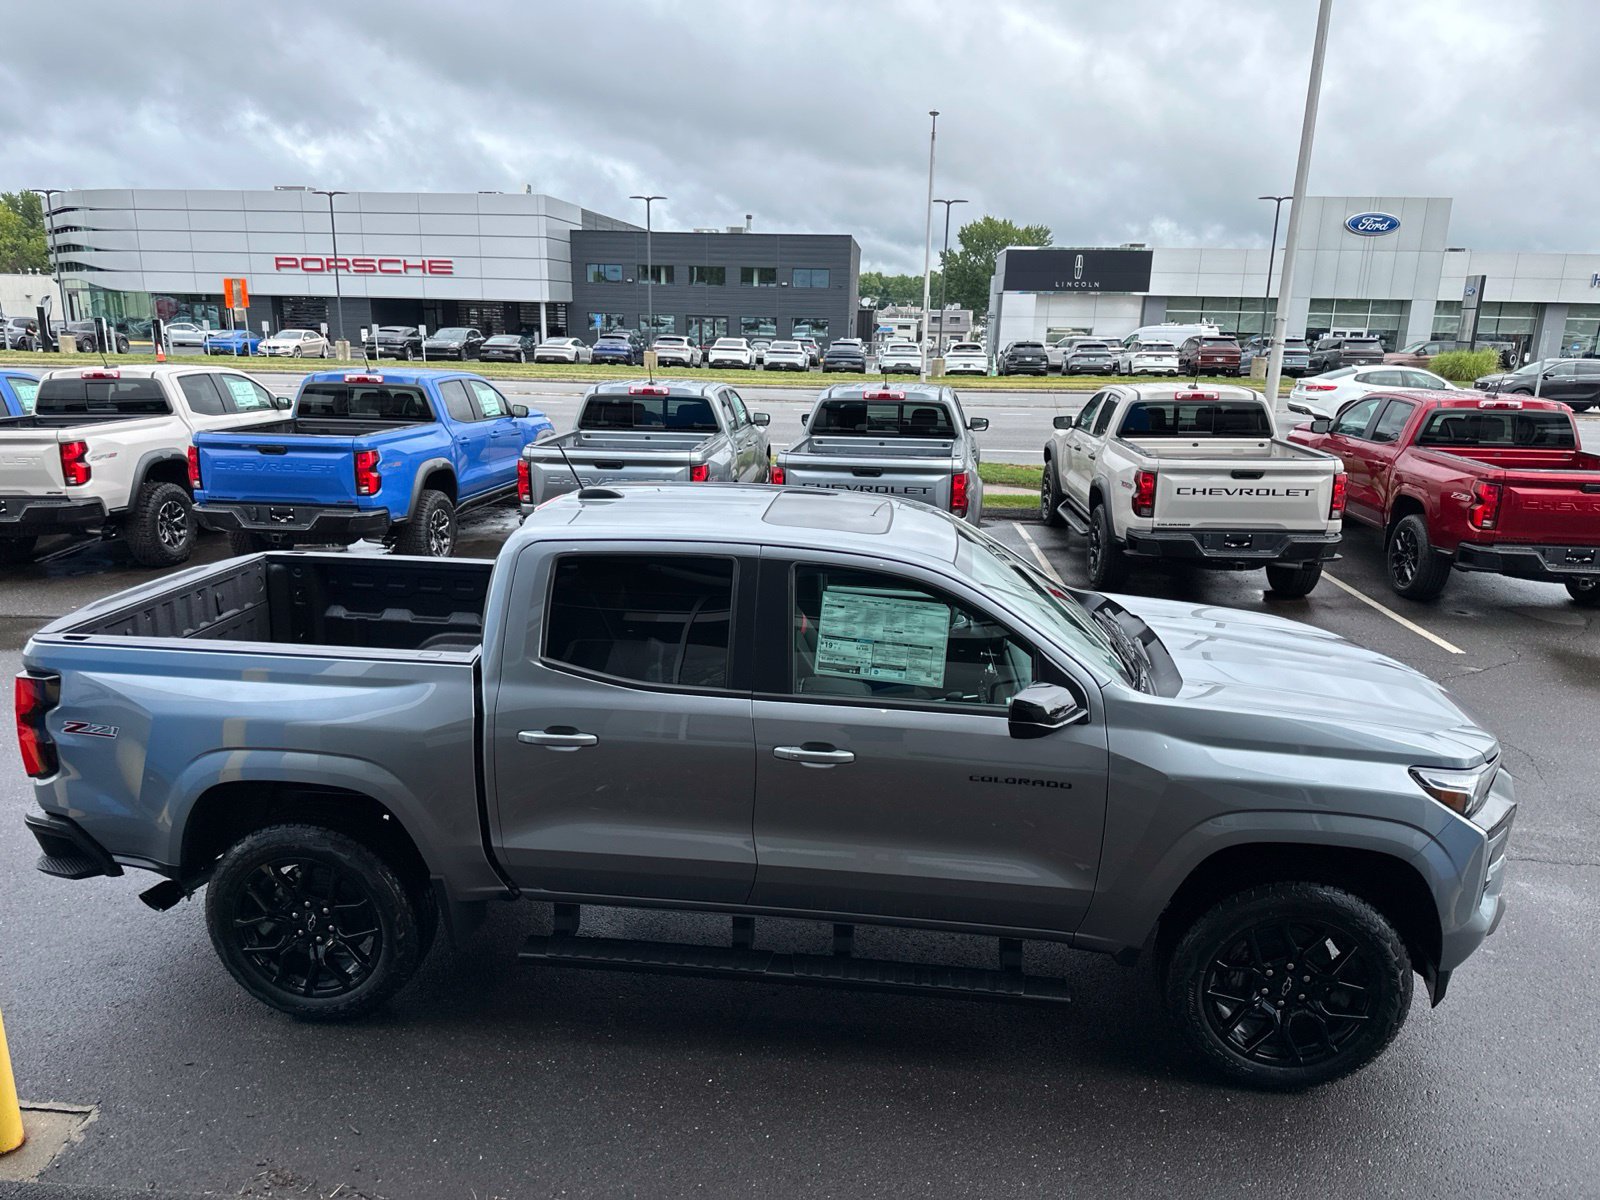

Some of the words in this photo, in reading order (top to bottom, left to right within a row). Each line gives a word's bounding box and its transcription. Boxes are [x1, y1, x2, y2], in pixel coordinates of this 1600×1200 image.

[1358, 217, 1390, 231] Ford
[274, 256, 454, 275] PORSCHE
[214, 461, 336, 474] CHEVROLET
[1176, 487, 1315, 497] CHEVROLET
[61, 721, 119, 740] Z71
[969, 775, 1073, 790] COLORADO
